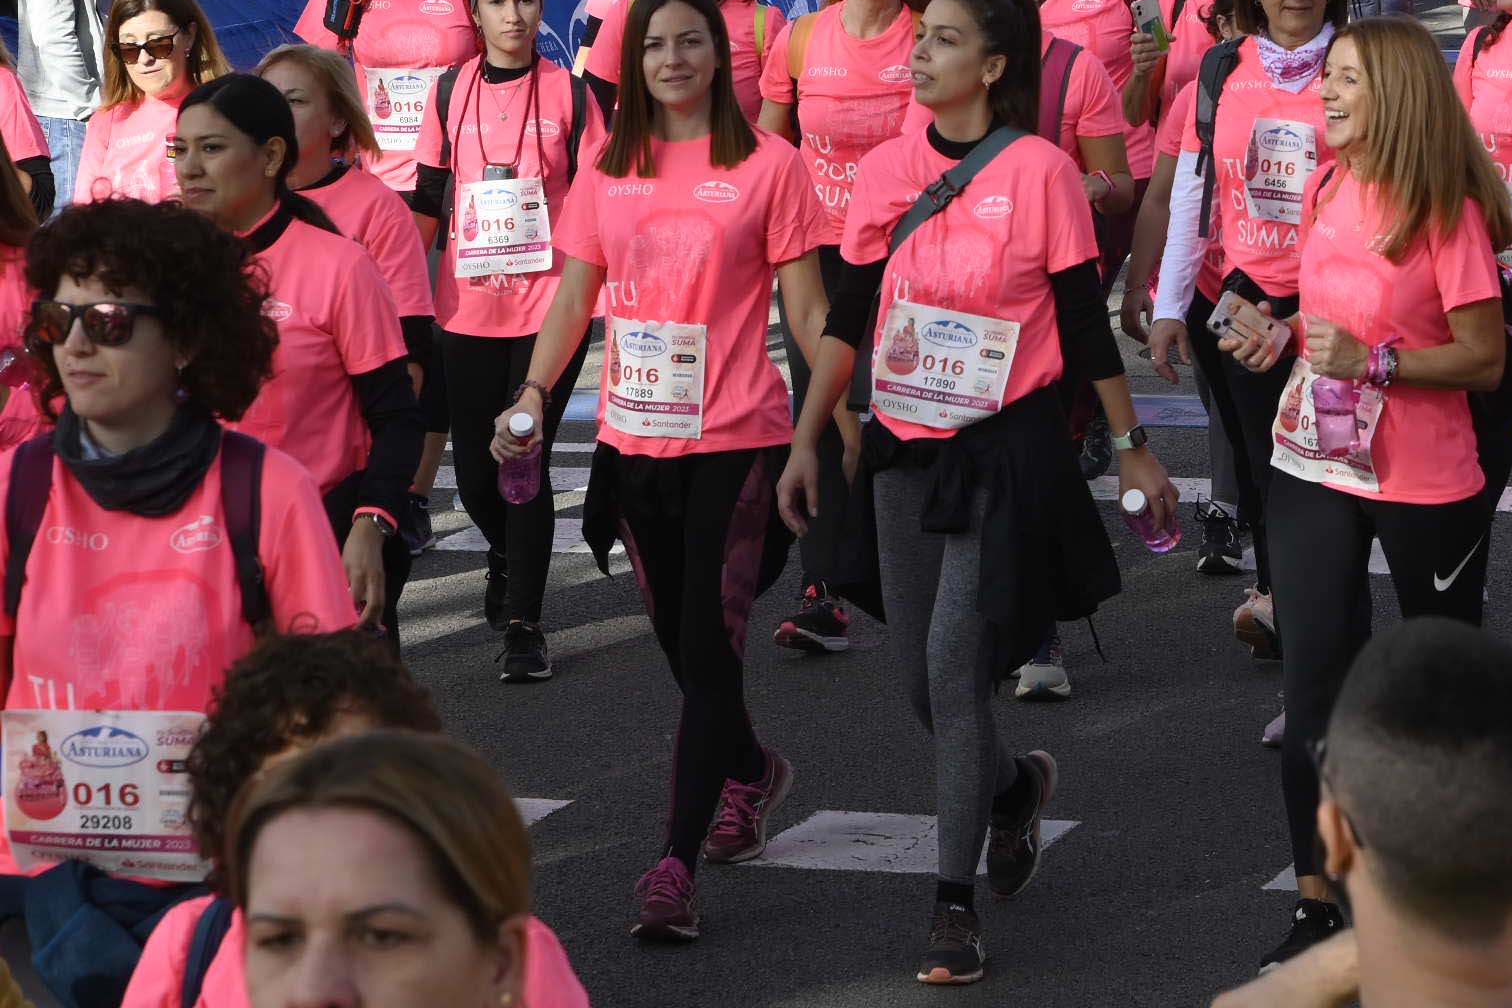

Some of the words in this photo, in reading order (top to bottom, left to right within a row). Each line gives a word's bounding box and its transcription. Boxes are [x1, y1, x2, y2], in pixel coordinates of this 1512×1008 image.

[808, 67, 848, 77] OYSHO
[394, 100, 424, 112] 016
[807, 132, 832, 154] TU
[1261, 159, 1296, 176] 016
[1264, 177, 1287, 188] 6456
[608, 183, 654, 198] OYSHO
[481, 217, 516, 232] 016
[606, 280, 637, 308] TU
[672, 339, 696, 347] SUMA
[925, 327, 973, 346] ASTURIANA
[624, 338, 663, 352] ASTURIANA
[922, 354, 966, 376] 016
[623, 365, 660, 384] 016
[923, 376, 956, 391] 17890
[625, 386, 654, 399] 17889
[887, 383, 921, 397] CARRERA
[922, 391, 933, 399] DE
[934, 393, 944, 401] LA
[945, 395, 970, 405] MUJER
[645, 404, 671, 412] MUJER
[882, 398, 918, 414] OYSHO
[652, 419, 692, 429] Santander
[67, 741, 142, 759] ASTURIANA
[72, 782, 140, 807] 016
[79, 814, 133, 831] 29208
[85, 837, 102, 848] DE
[103, 838, 120, 849] LA
[121, 838, 161, 849] MUJER
